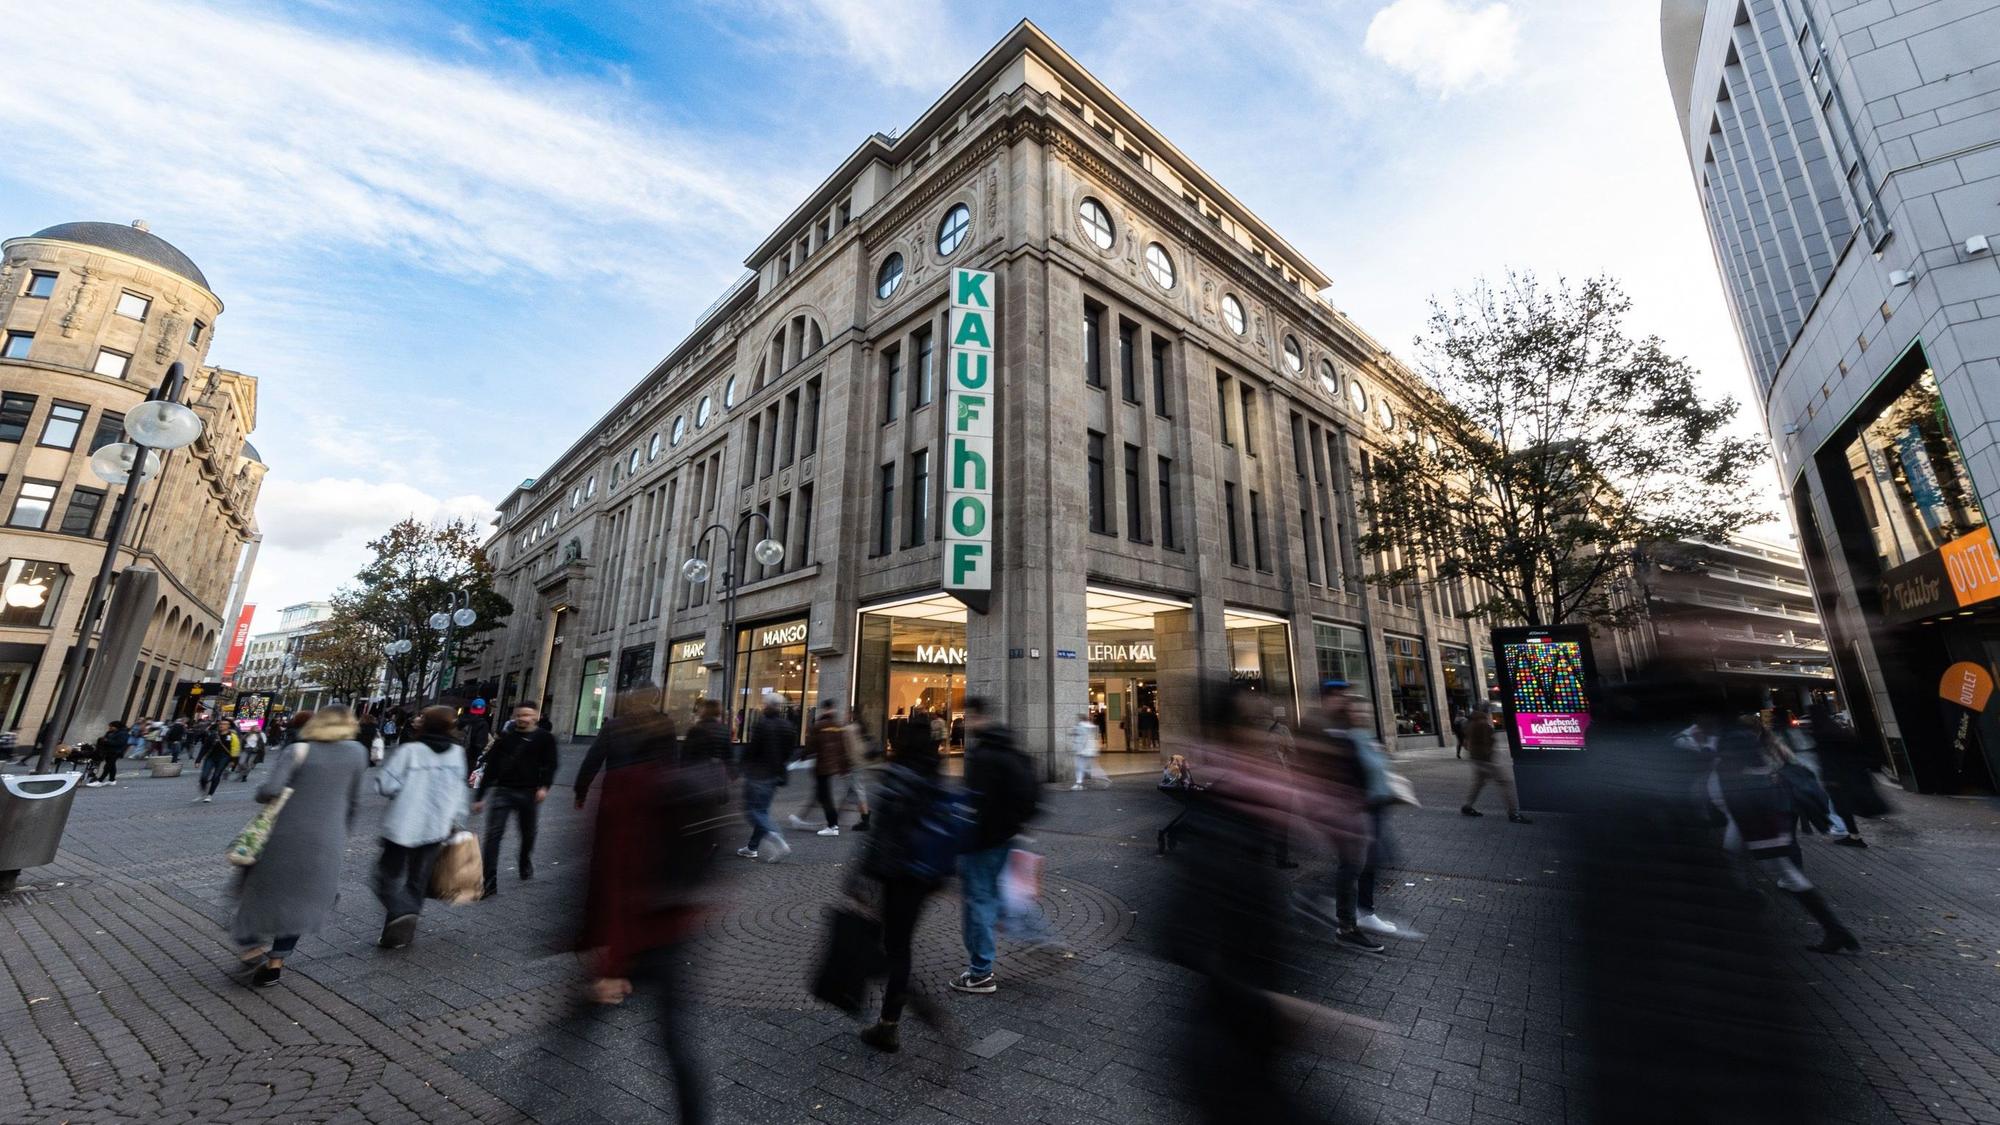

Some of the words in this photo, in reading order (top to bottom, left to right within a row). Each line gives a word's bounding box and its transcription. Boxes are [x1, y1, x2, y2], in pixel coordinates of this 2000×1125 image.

[1893, 575, 1940, 610] Tchibo
[763, 624, 807, 647] MANGO
[1087, 645, 1128, 660] LERIA
[1960, 670, 1977, 705] OUTLET
